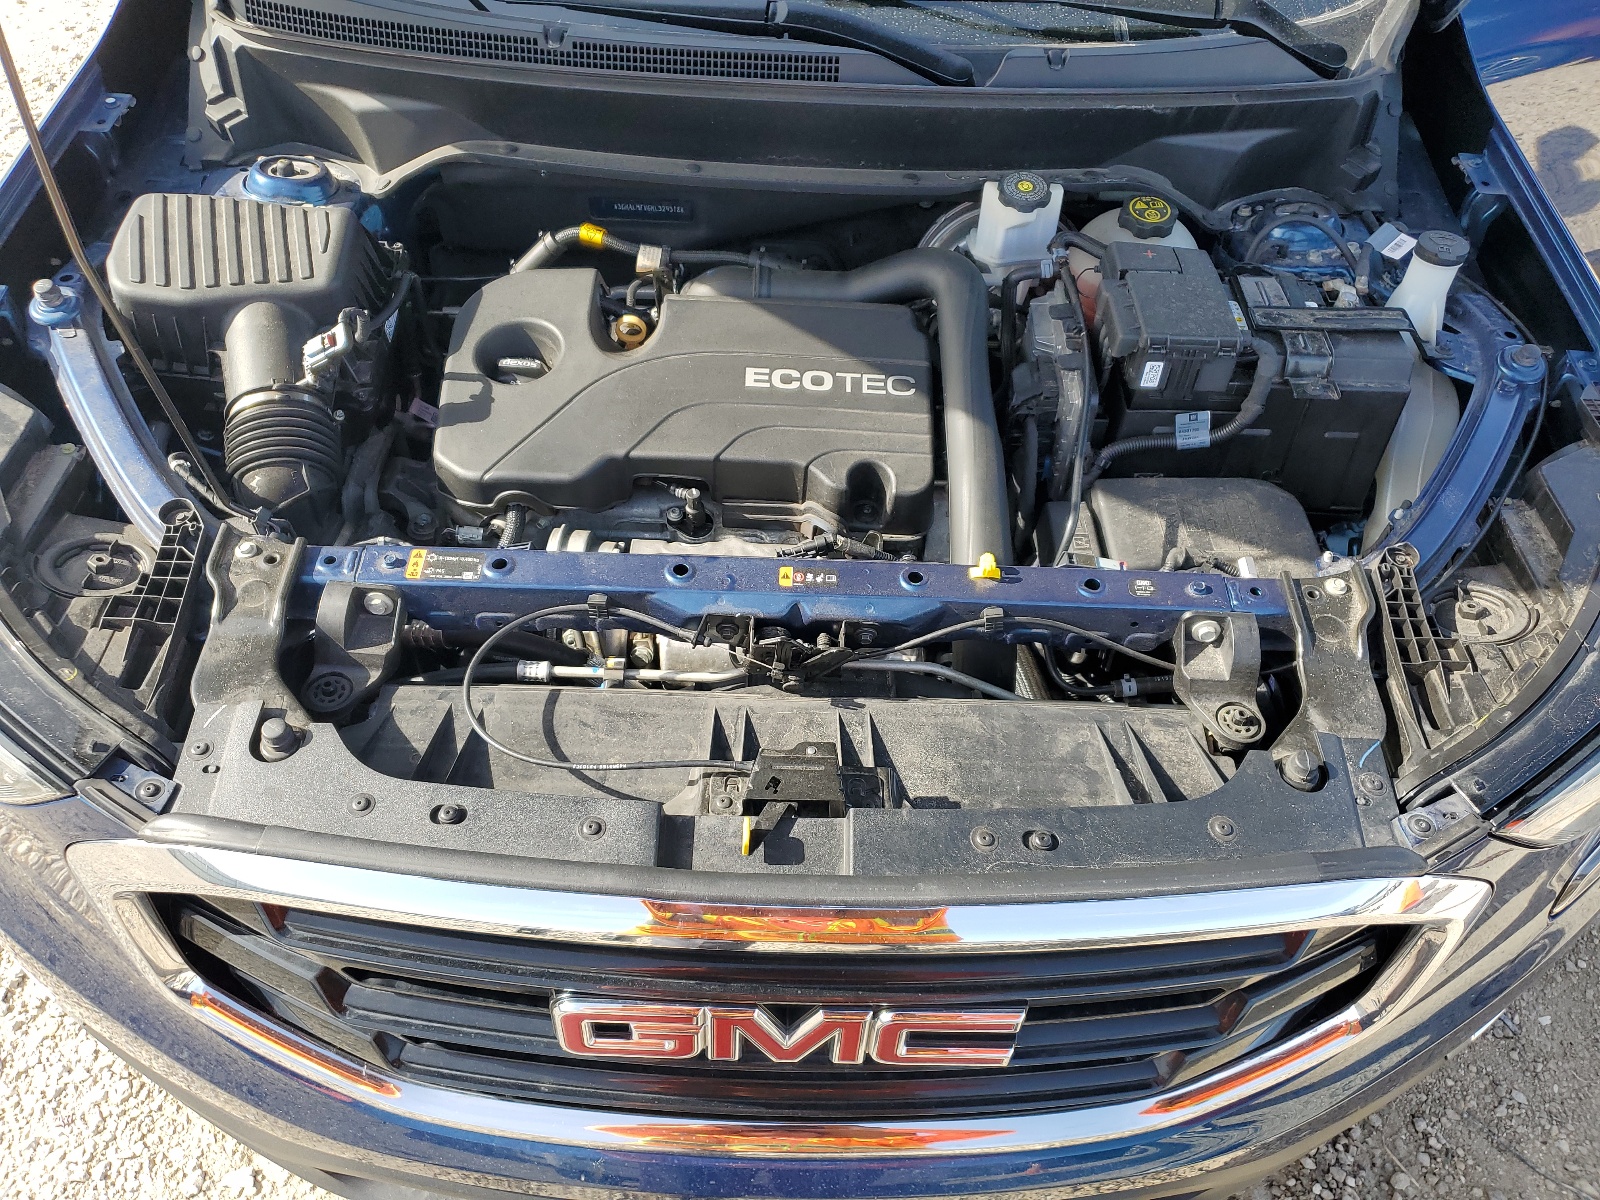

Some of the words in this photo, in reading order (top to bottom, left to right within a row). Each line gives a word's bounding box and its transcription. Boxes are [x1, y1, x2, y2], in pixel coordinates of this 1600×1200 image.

[502, 358, 538, 368] dexos
[744, 366, 916, 396] ECOTEC
[550, 993, 1028, 1066] GMC
